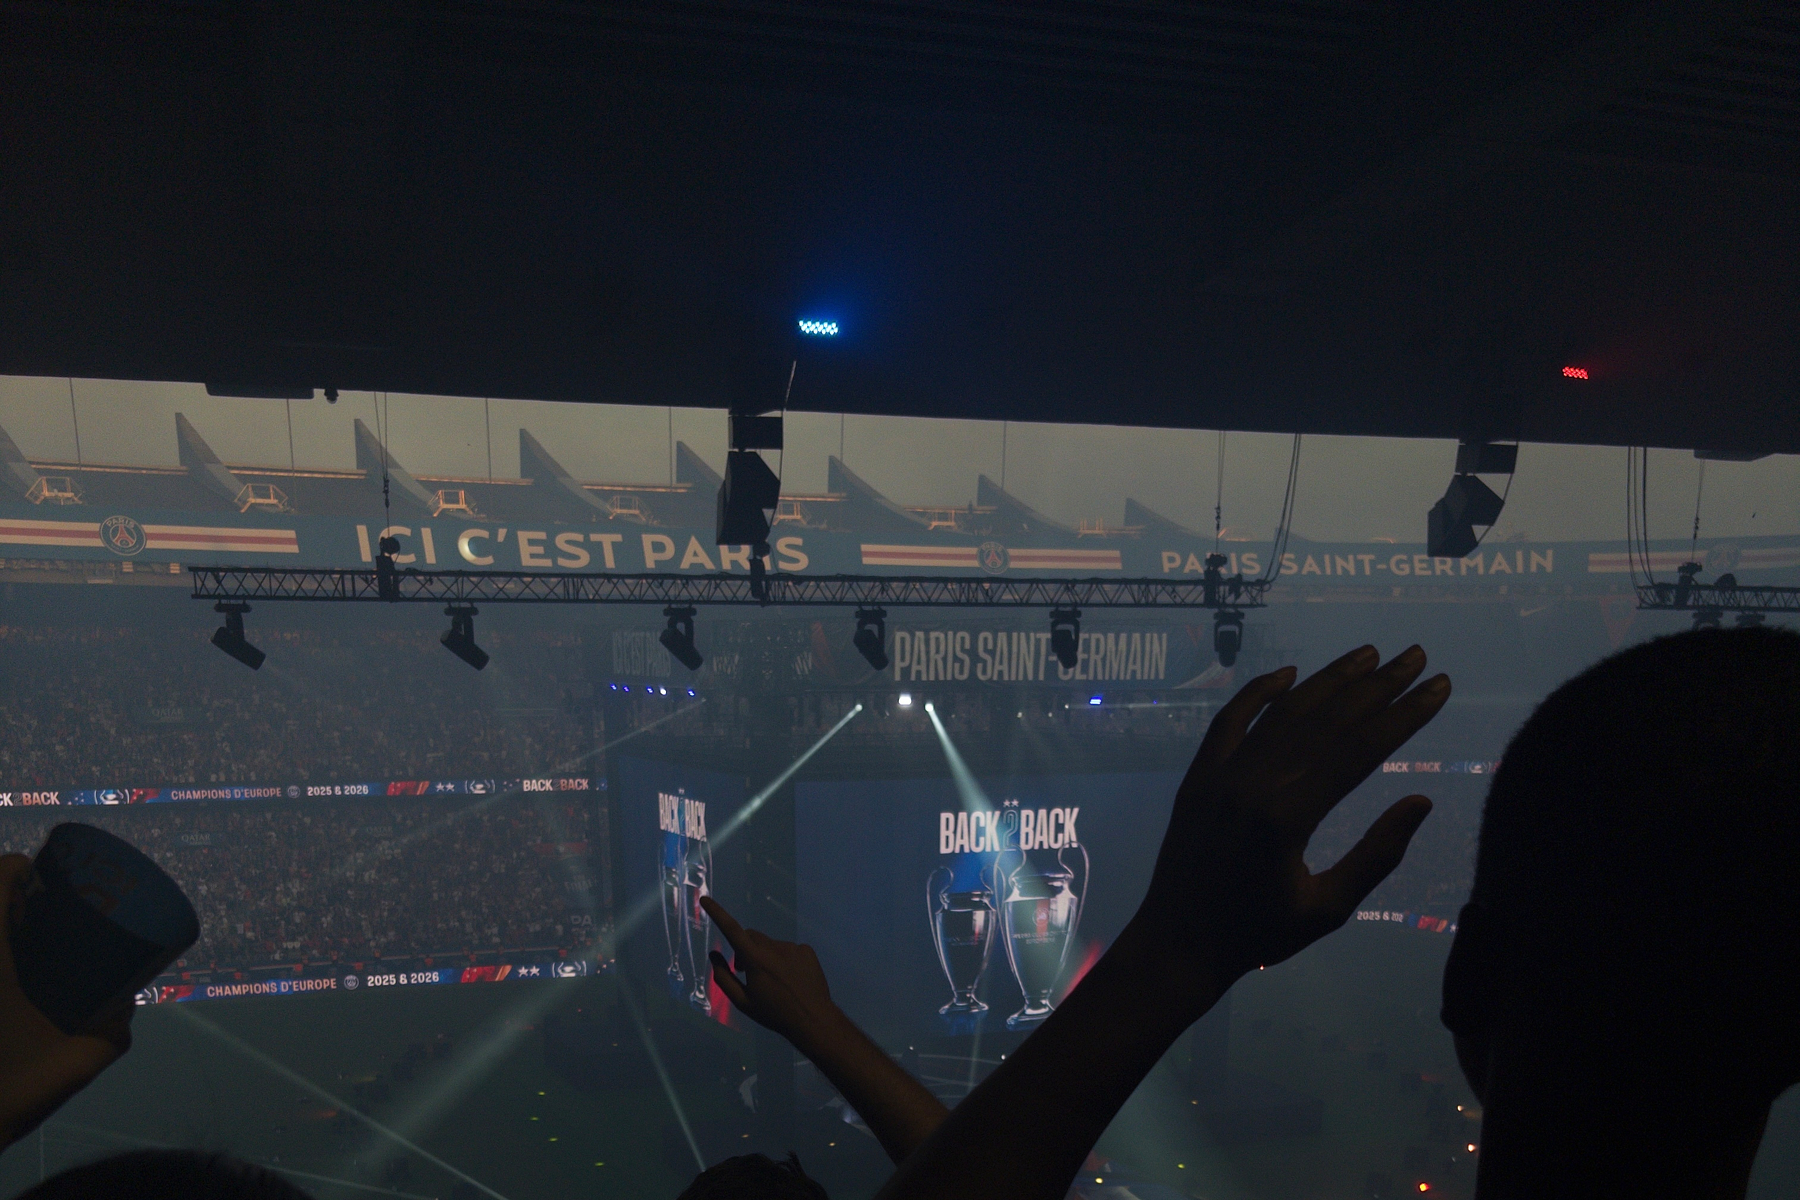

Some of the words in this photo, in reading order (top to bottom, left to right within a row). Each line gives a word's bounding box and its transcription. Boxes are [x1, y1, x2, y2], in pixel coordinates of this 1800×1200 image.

[356, 524, 436, 565] ICI
[457, 528, 624, 569] C'EST
[640, 533, 810, 572] PARS
[1161, 551, 1261, 575] PAIS
[1279, 549, 1554, 576] SAINT-GERMAIN
[894, 631, 971, 681] PARIS
[170, 787, 231, 801] CHAMPIONS
[234, 786, 282, 799] D'EUROPE
[306, 785, 333, 797] 2025
[343, 784, 369, 796] 2026
[1357, 910, 1381, 921] 2025
[206, 982, 278, 998] CHAMPIONS
[281, 977, 337, 994] D'EUROPE
[366, 973, 397, 988] 2025
[410, 971, 440, 986] 2026
